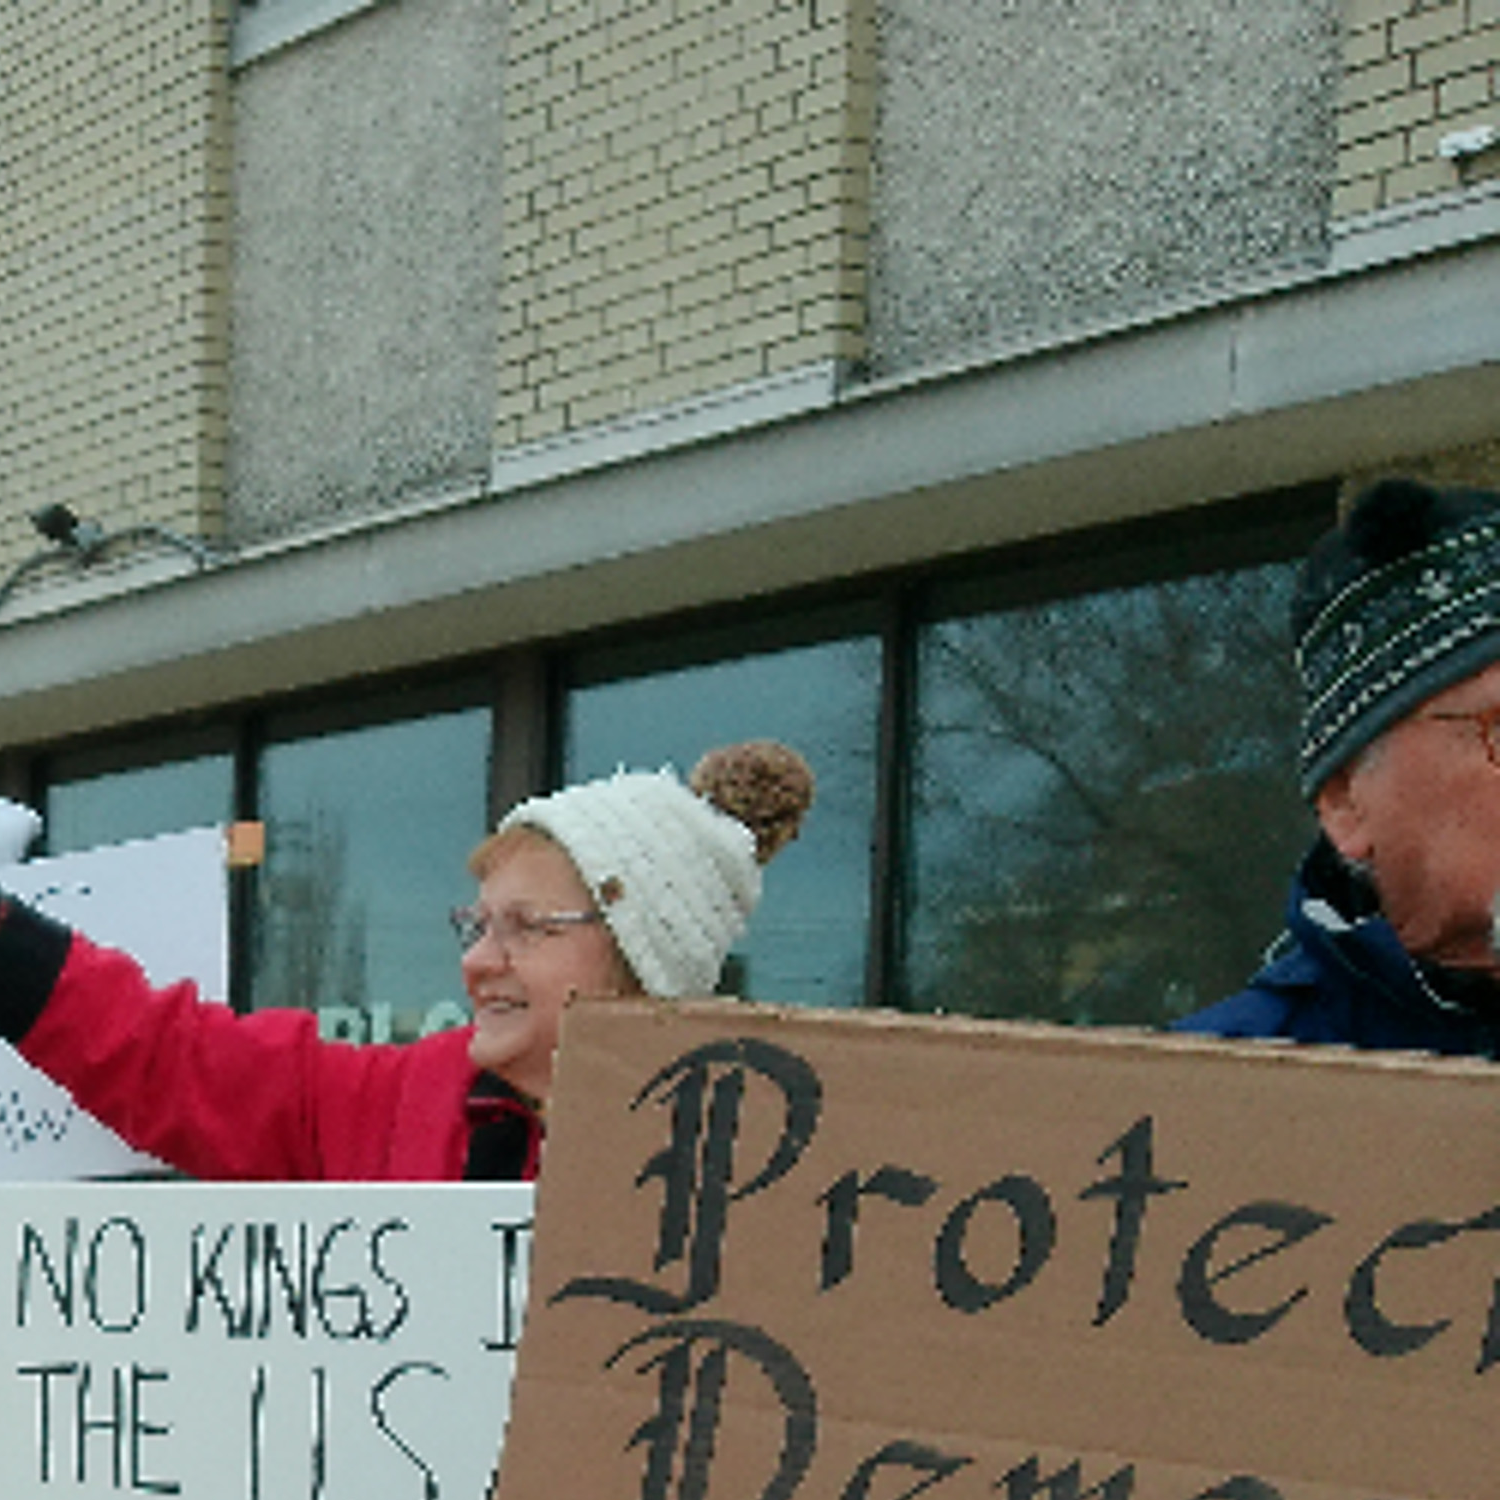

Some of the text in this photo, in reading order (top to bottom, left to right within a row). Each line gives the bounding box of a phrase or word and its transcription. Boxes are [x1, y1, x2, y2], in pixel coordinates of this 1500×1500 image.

[17, 1216, 534, 1350] NO KINGS I
[16, 1362, 182, 1495] THE
